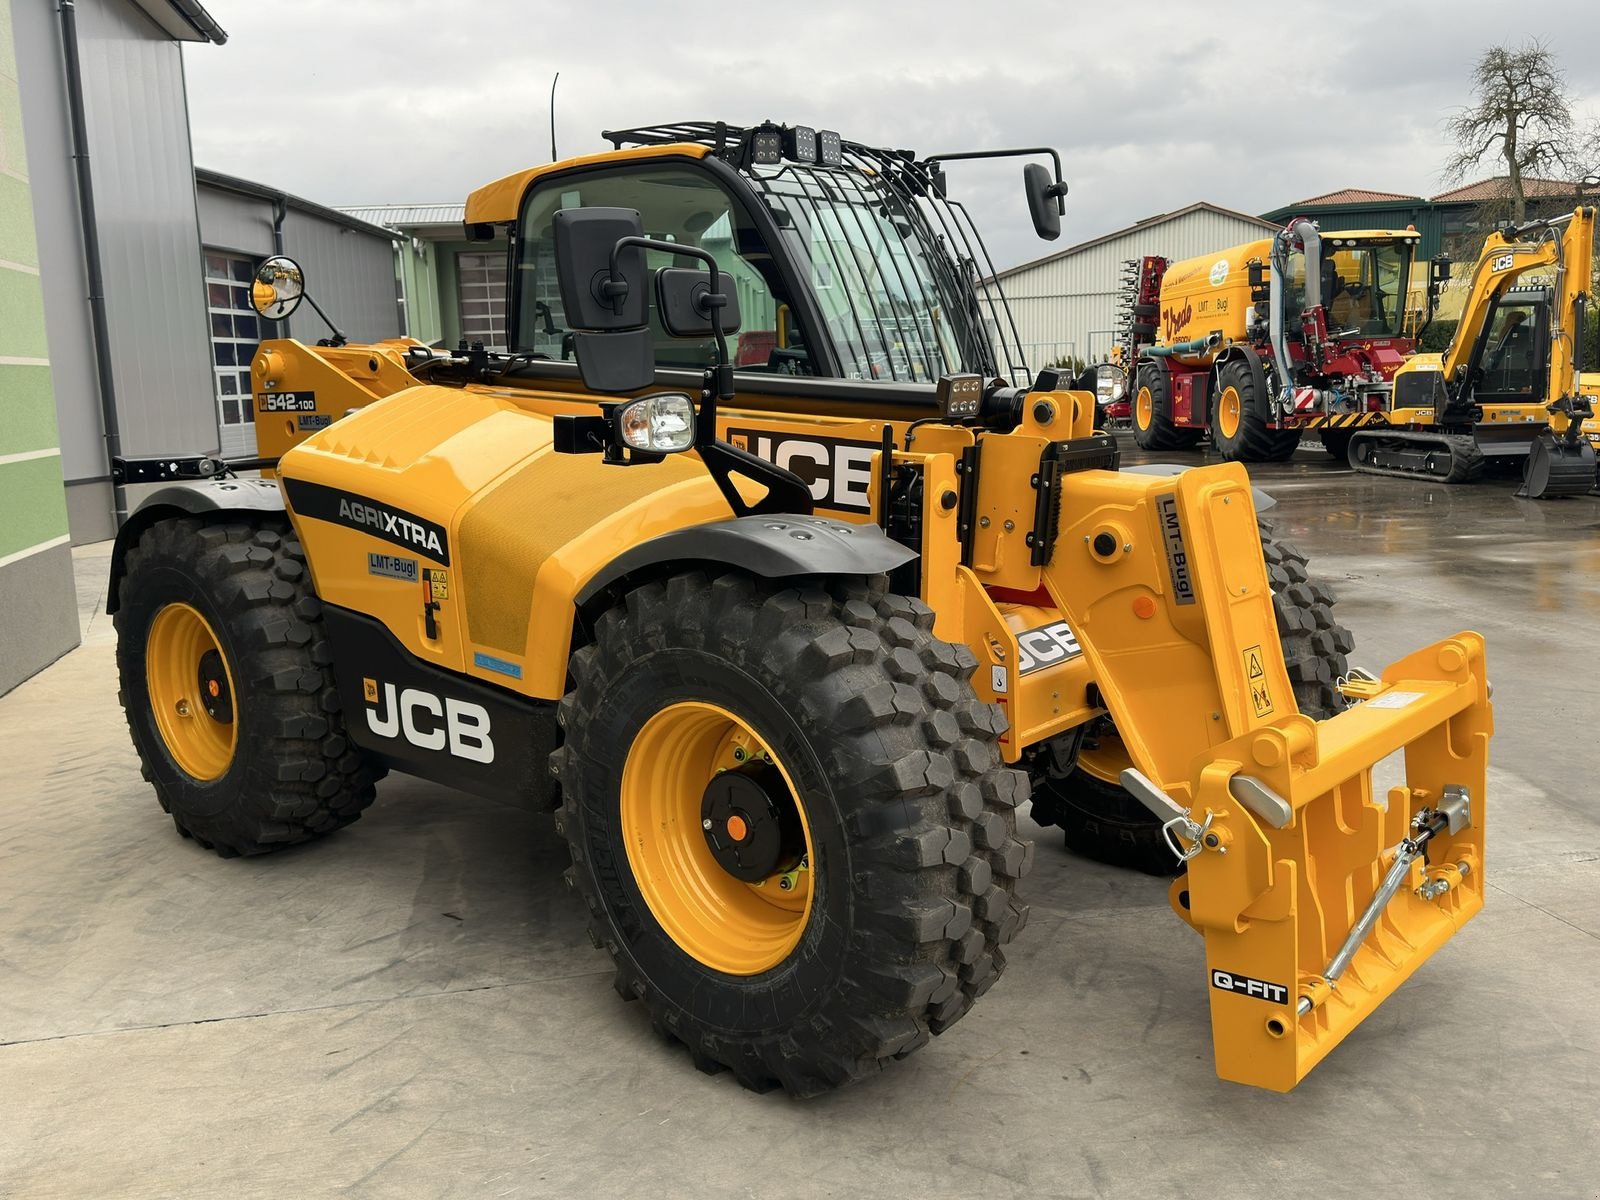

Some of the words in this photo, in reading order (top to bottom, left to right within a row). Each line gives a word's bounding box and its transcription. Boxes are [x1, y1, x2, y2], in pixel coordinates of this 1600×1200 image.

[1492, 255, 1513, 272] JCB
[1162, 296, 1192, 342] Vredo
[339, 498, 444, 556] AGRIXTRA
[1162, 499, 1194, 599] LMT-Bugl
[370, 553, 417, 577] LMT-Bugl
[365, 682, 495, 764] JCB
[1213, 971, 1287, 1002] Q-FIT
